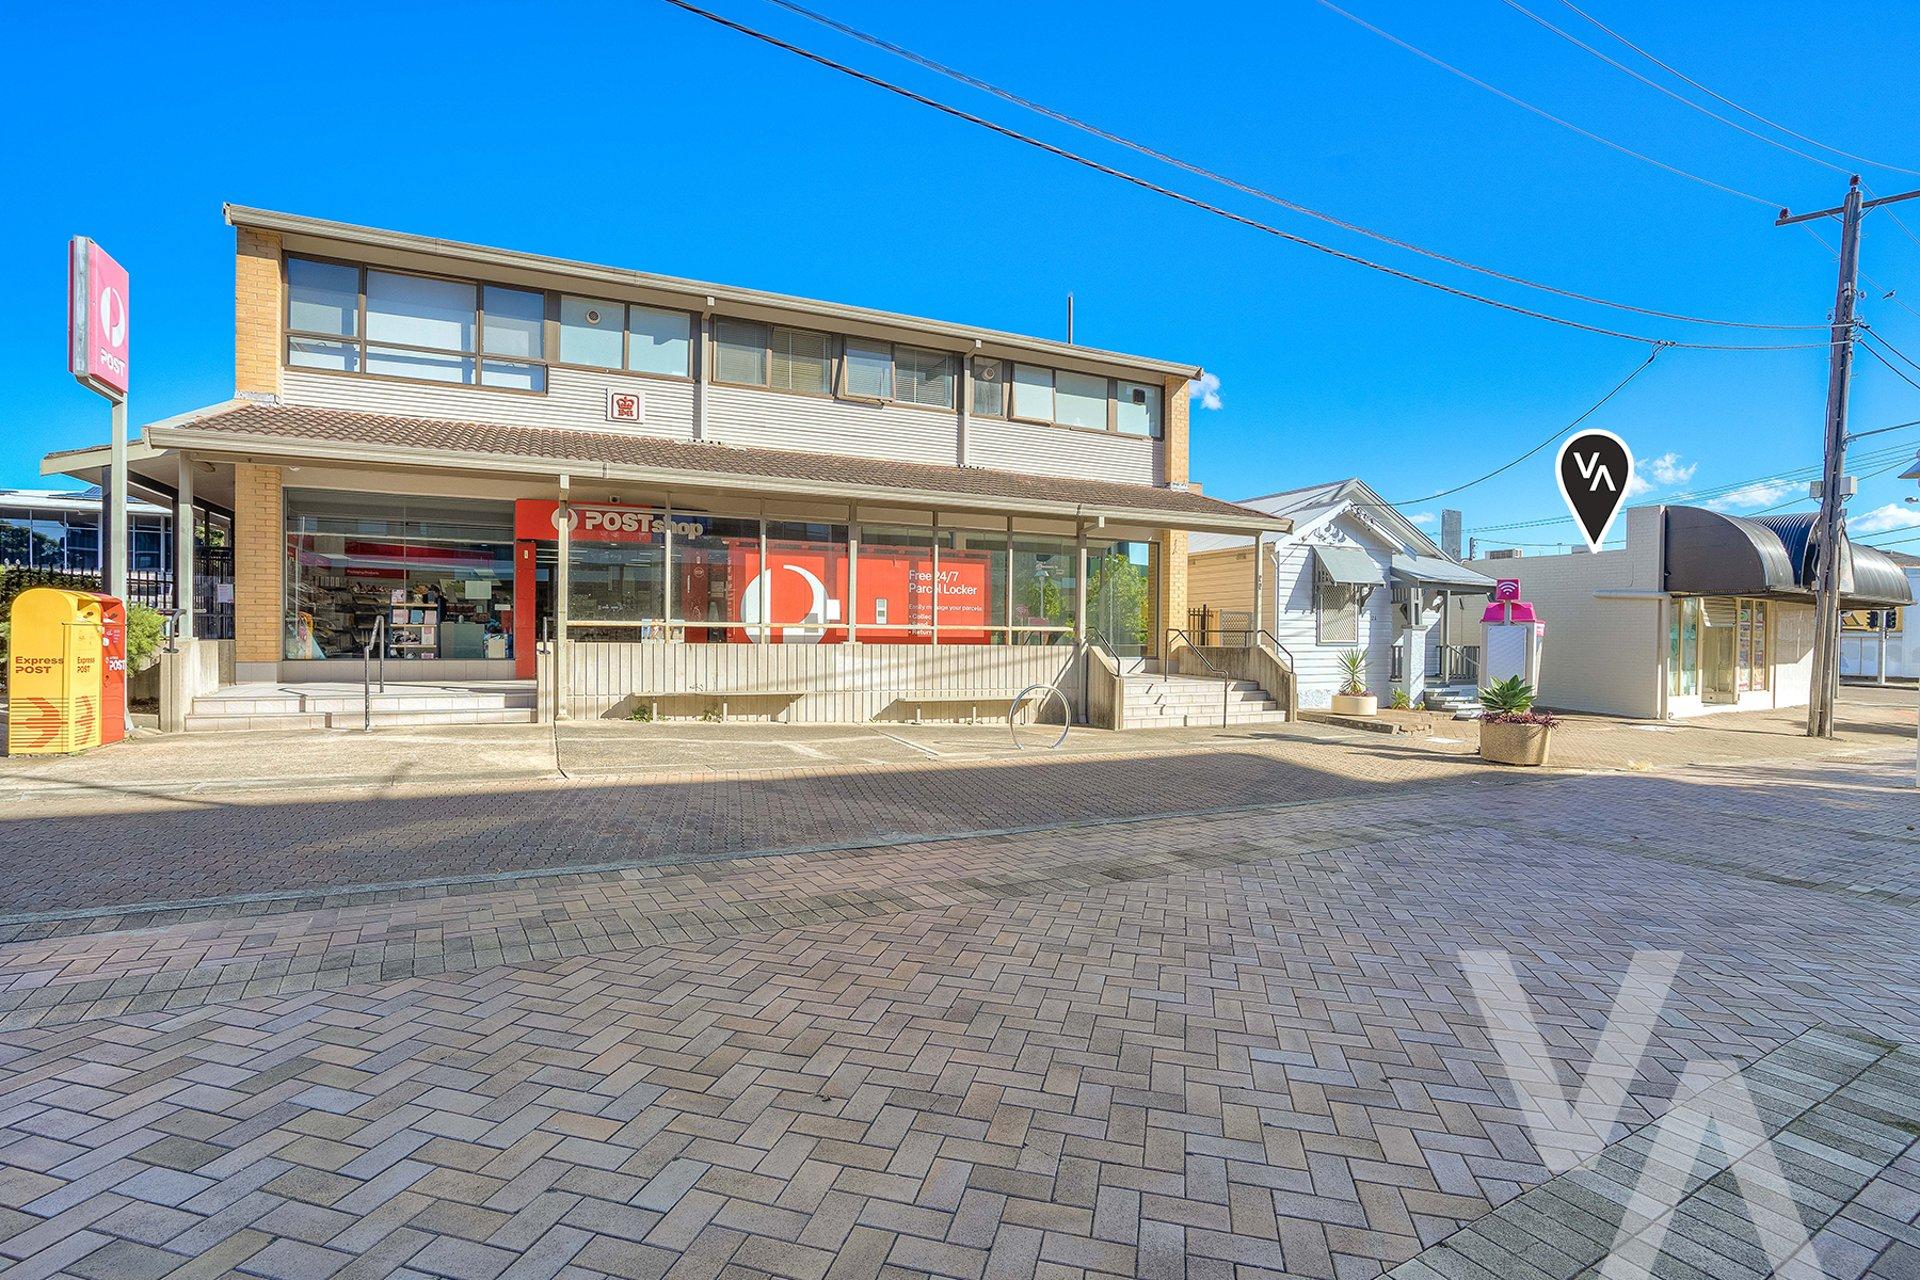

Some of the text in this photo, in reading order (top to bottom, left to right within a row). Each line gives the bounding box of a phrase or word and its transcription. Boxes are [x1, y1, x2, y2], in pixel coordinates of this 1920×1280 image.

[100, 347, 127, 377] POST
[909, 570, 932, 581] Free
[909, 583, 978, 595] Parcl Locker
[15, 656, 64, 666] Express
[77, 656, 95, 665] Express
[15, 666, 51, 674] POST
